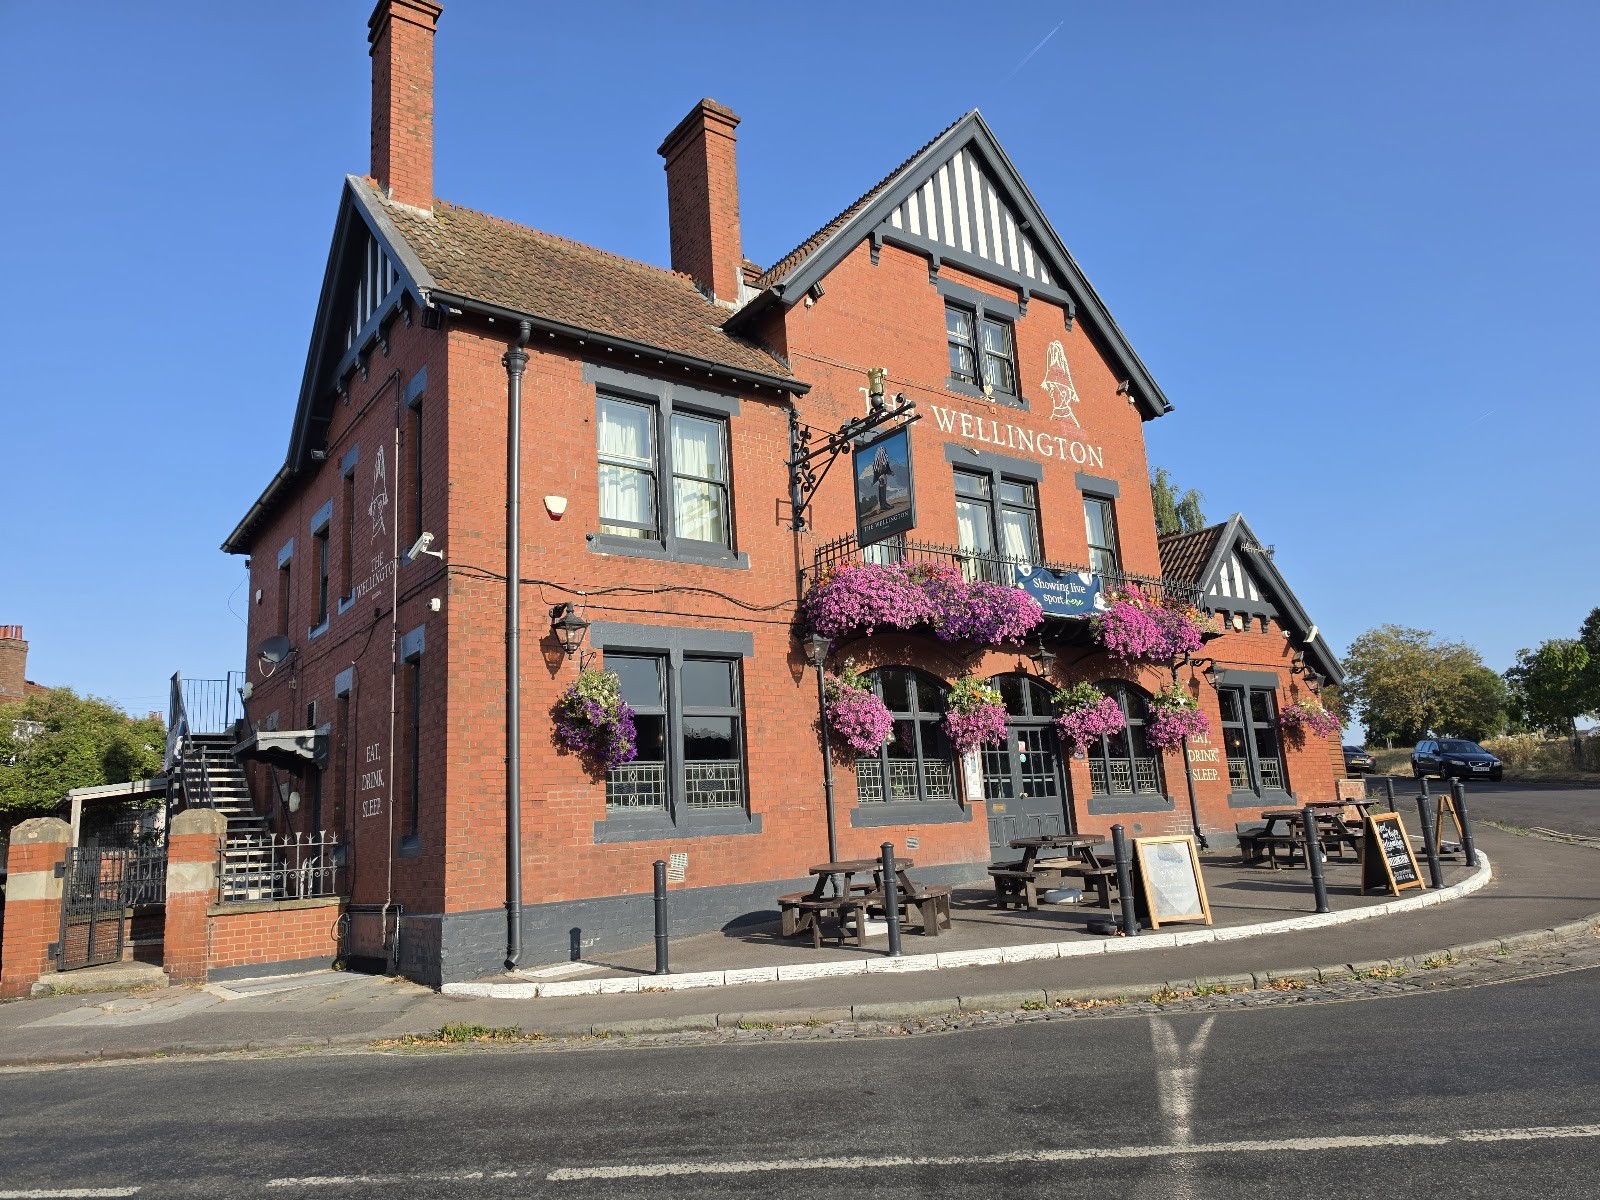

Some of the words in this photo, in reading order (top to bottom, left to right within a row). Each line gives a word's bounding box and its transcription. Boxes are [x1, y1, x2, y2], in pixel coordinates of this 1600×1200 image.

[931, 404, 1104, 469] WELLINGTON
[875, 511, 908, 527] WELLINGTON
[371, 551, 383, 572] THE
[1033, 578, 1069, 594] Showing
[1070, 583, 1085, 593] live
[1043, 594, 1065, 605] sport
[366, 743, 380, 762] EAT,
[1187, 749, 1220, 763] DRINK,
[361, 769, 384, 791] DRINK,
[1192, 768, 1220, 781] SLEEP.
[362, 797, 383, 817] SLEEP.
